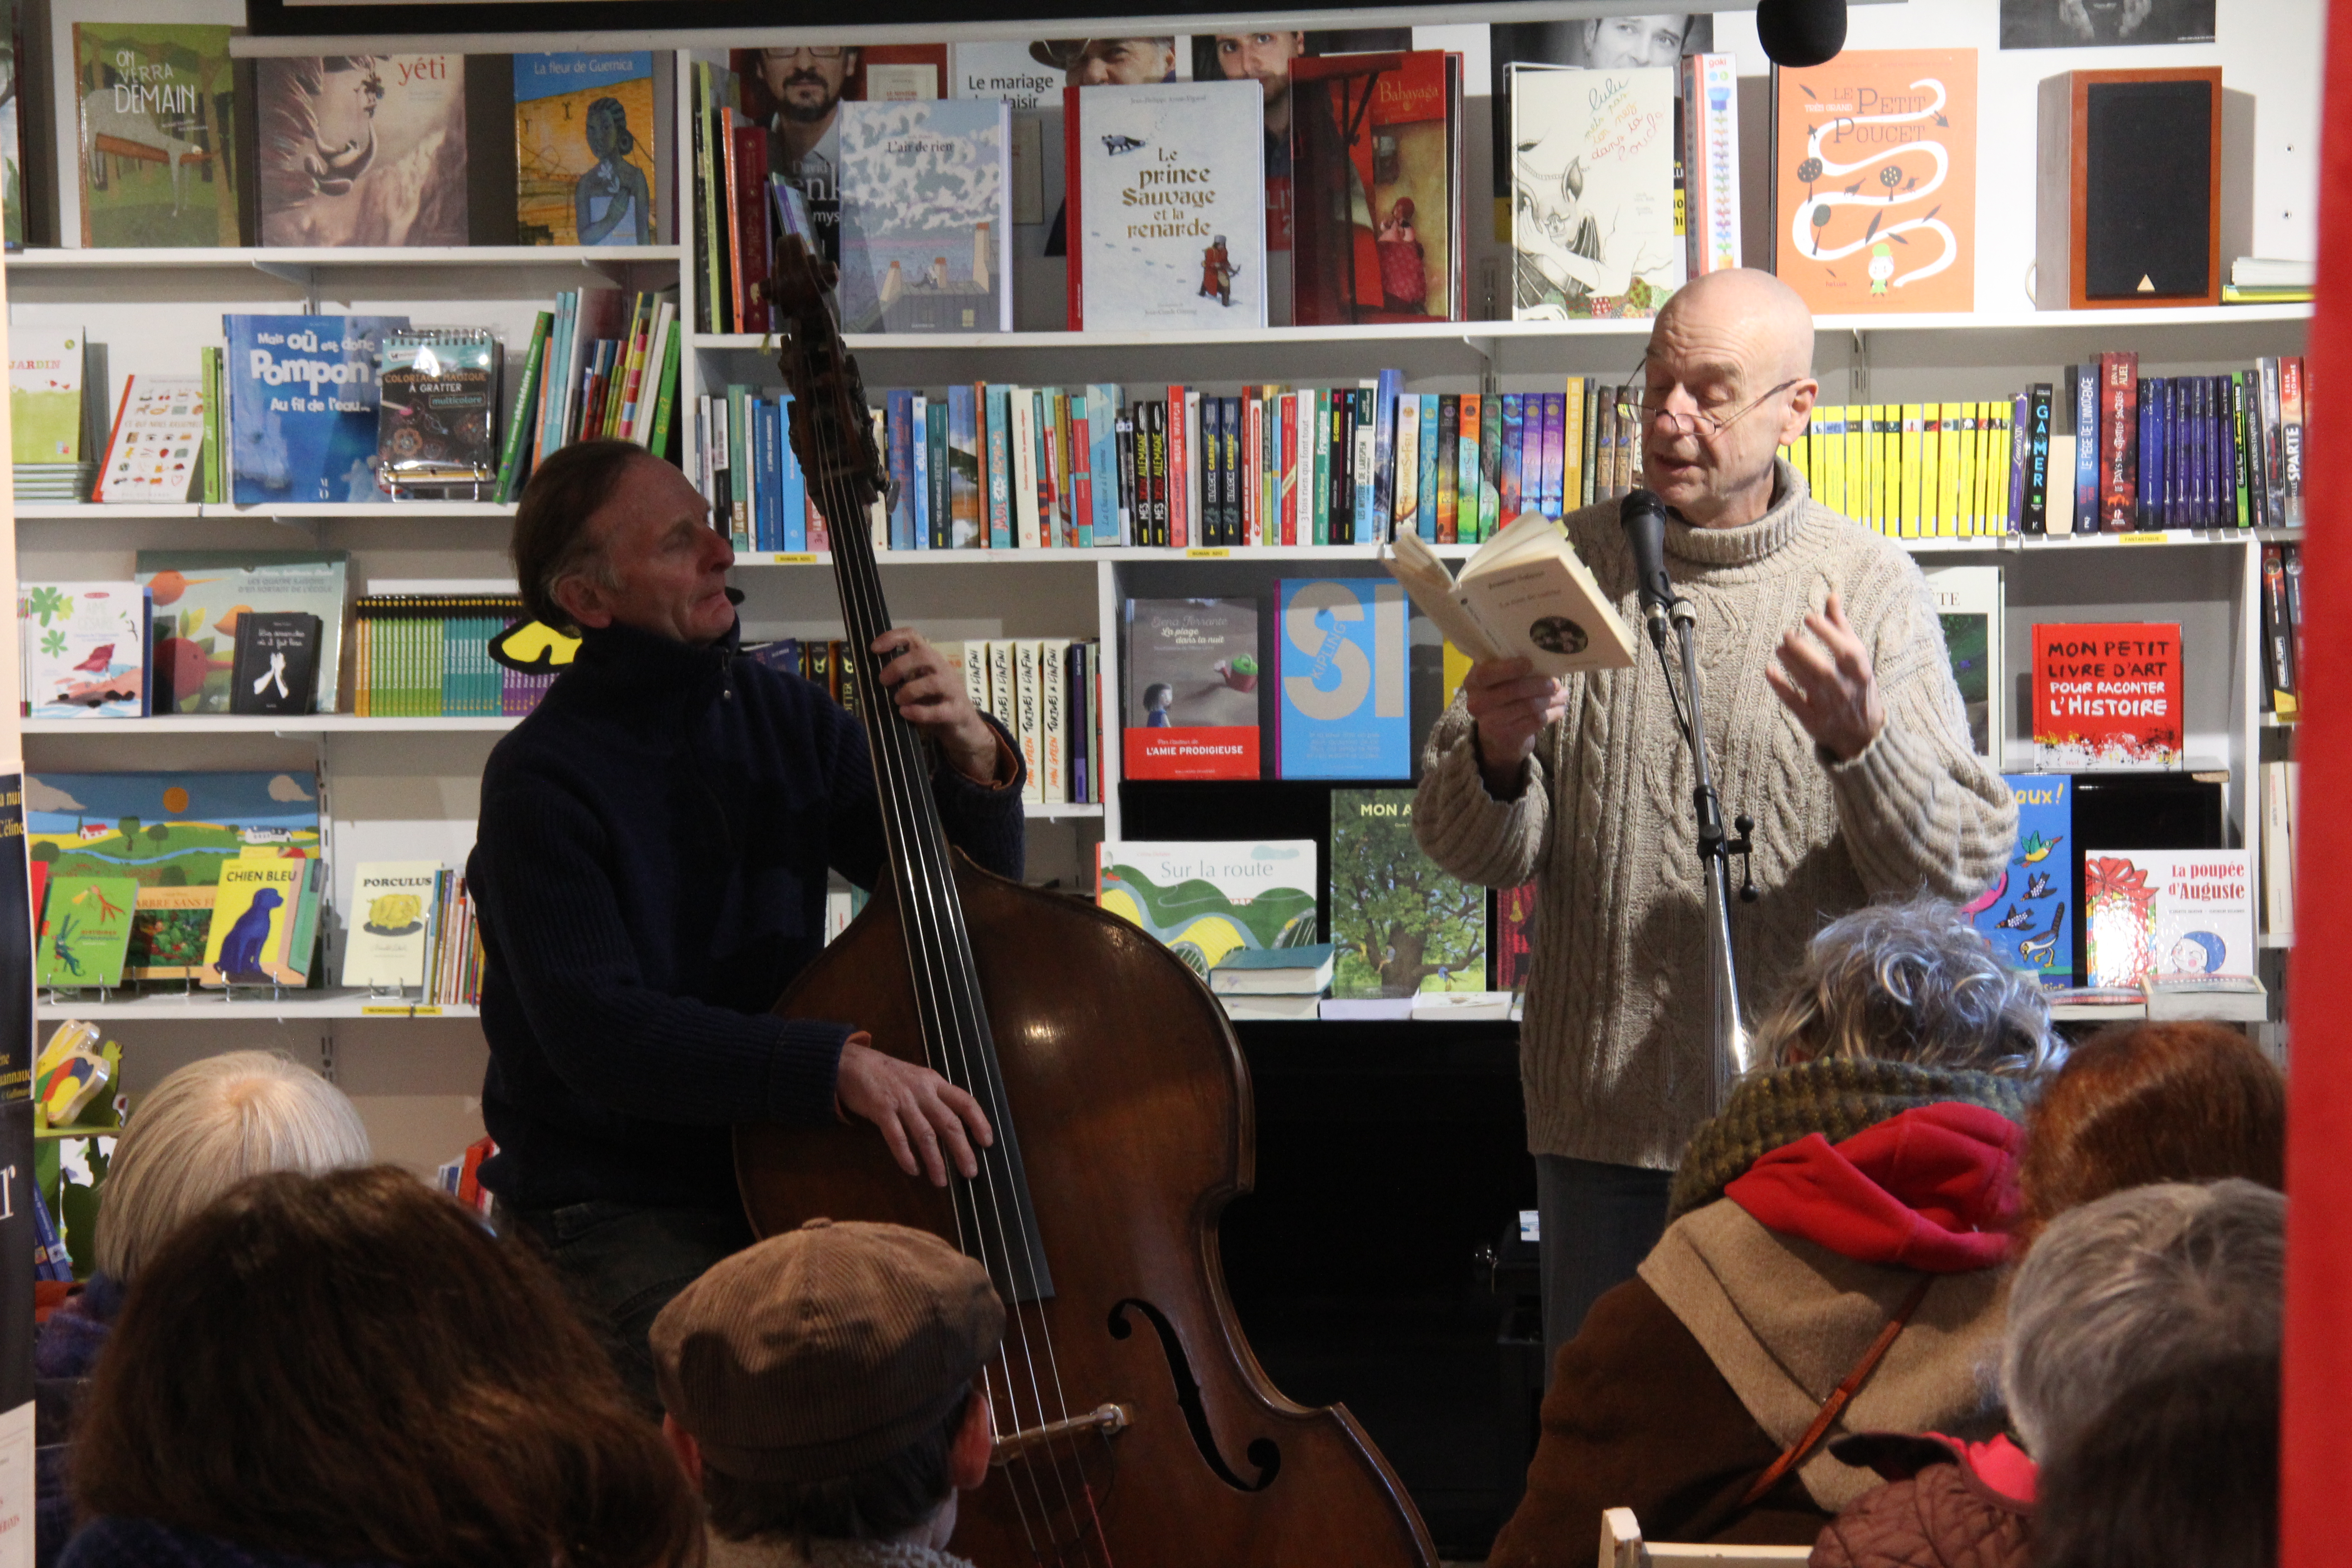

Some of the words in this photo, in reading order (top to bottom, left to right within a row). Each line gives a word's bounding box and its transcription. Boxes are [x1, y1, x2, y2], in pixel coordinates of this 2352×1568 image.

[117, 50, 135, 67] ON
[534, 63, 547, 75] La
[549, 62, 569, 74] fleur
[574, 62, 587, 74] de
[589, 59, 633, 73] Guernica
[1709, 57, 1727, 69] goki
[119, 63, 174, 84] VERRA
[397, 56, 446, 86] yéti
[968, 75, 985, 90] Le
[990, 74, 1054, 91] mariage
[114, 84, 195, 113] DEMAIN
[1378, 81, 1440, 104] Babayaga
[1833, 88, 1852, 100] LE
[1856, 87, 1926, 114] PETIT
[1825, 103, 1853, 113] GRAND
[1833, 116, 1926, 144] POUCET
[887, 140, 913, 153] L'air
[916, 141, 928, 153] de
[931, 141, 953, 153] rien
[1159, 147, 1178, 163] Le
[1138, 164, 1211, 189] prince
[1122, 187, 1215, 208] Sauvage
[1153, 209, 1169, 221] et
[1172, 207, 1184, 220] la
[1127, 218, 1211, 239] renarde
[257, 333, 284, 345] Mais
[287, 330, 318, 353] où
[341, 337, 375, 352] donc
[9, 360, 61, 370] JARDIN
[250, 348, 369, 396] Pompon
[2119, 364, 2128, 385] AUEL
[409, 382, 416, 393] À
[420, 383, 462, 392] GRATTER
[270, 396, 289, 412] Au
[292, 396, 305, 412] fil
[307, 398, 325, 412] de
[431, 395, 482, 405] multicolore
[2080, 377, 2093, 423] L'INNOCENCE
[1317, 410, 1329, 455] Frangine
[2014, 423, 2023, 439] XIV
[2081, 425, 2092, 436] DE
[2113, 421, 2124, 450] GROTTES
[2248, 412, 2258, 442] DAMNÉES
[1299, 441, 1308, 458] font
[2013, 438, 2023, 469] Louis
[2033, 405, 2049, 487] GAMER
[2080, 438, 2093, 459] PIÈGE
[2285, 427, 2301, 481] SPARTE
[2081, 461, 2093, 470] LE
[2250, 442, 2259, 471] AMOURS
[1301, 461, 1309, 475] qui
[1358, 471, 1365, 480] DE
[2112, 463, 2123, 483] PAYS
[1207, 472, 1216, 502] BLACK
[1227, 472, 1235, 502] BLACK
[1139, 503, 1148, 520] MES
[1154, 503, 1164, 520] MES
[1298, 498, 1308, 514] fois
[1101, 515, 1109, 526] La
[1161, 627, 1174, 637] La
[1175, 627, 1199, 637] plage
[1175, 635, 1196, 644] dans
[1197, 635, 1207, 644] la
[1208, 635, 1225, 644] nuit
[1284, 580, 1404, 720] SI
[1311, 622, 1346, 680] KIPLING
[2048, 642, 2097, 658] MON
[2104, 641, 2170, 657] PETIT
[2048, 663, 2106, 678] LIVRE
[2113, 662, 2167, 677] D'ART
[2050, 681, 2093, 695] POUR
[2097, 681, 2166, 695] RACONTER
[1021, 695, 1034, 733] TORTUES
[1046, 695, 1059, 733] TORTUES
[2050, 694, 2167, 716] L'HISTOIRE
[1024, 735, 1035, 766] GREEN
[1049, 735, 1059, 765] GREEN
[1146, 747, 1176, 756] L'AMIE
[1179, 745, 1243, 756] PRODIGIEUSE
[1361, 804, 1398, 817] MON
[227, 871, 264, 882] CHIEN
[265, 870, 297, 882] BLEU
[1161, 862, 1191, 879] Sur
[1200, 861, 1216, 877] la
[1224, 862, 1274, 877] route
[2172, 865, 2186, 878] La
[2190, 861, 2245, 880] poupée
[363, 877, 432, 887] PORCULUS
[2168, 882, 2245, 902] d'Auguste
[173, 898, 201, 908] SANS
